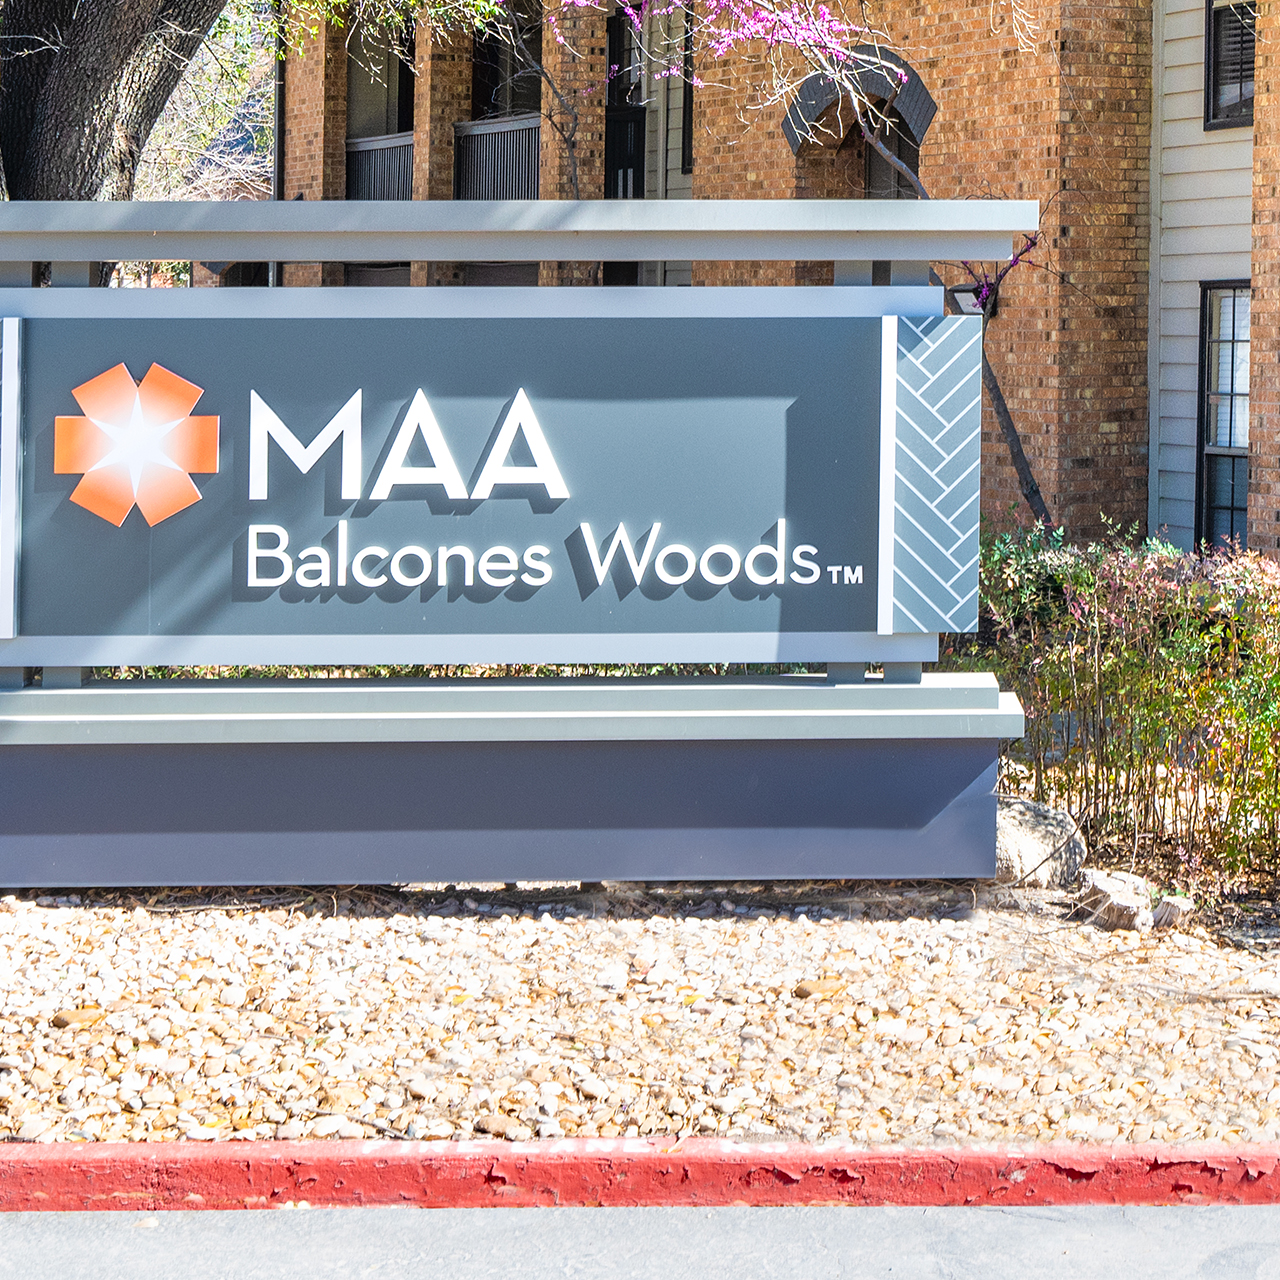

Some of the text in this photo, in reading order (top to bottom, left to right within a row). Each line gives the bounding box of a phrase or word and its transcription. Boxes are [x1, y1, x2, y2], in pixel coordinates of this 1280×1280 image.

[248, 387, 570, 500] MAA
[247, 519, 553, 587] Balcones
[580, 518, 821, 586] Woods
[362, 1140, 483, 1154] FIRE
[510, 1139, 651, 1153] LANE
